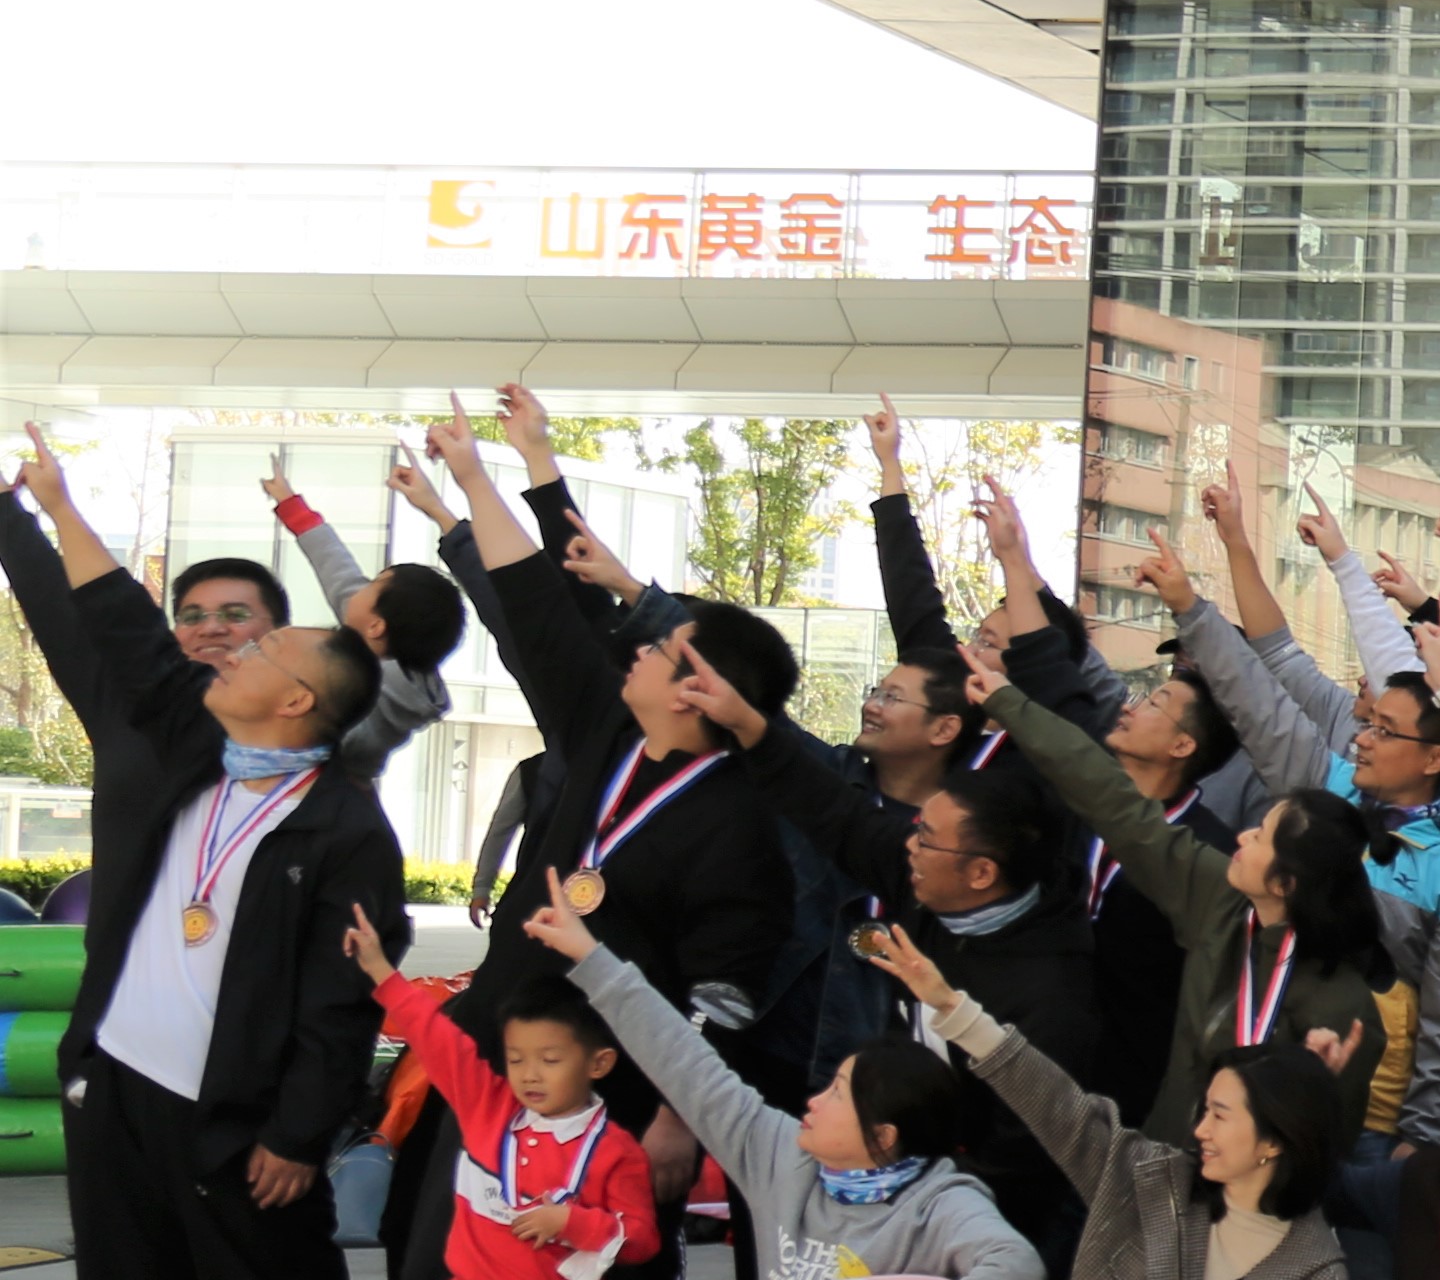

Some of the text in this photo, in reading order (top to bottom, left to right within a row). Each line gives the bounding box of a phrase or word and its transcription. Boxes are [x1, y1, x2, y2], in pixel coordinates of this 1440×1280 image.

[540, 192, 1076, 266] 山东黄金 生态
